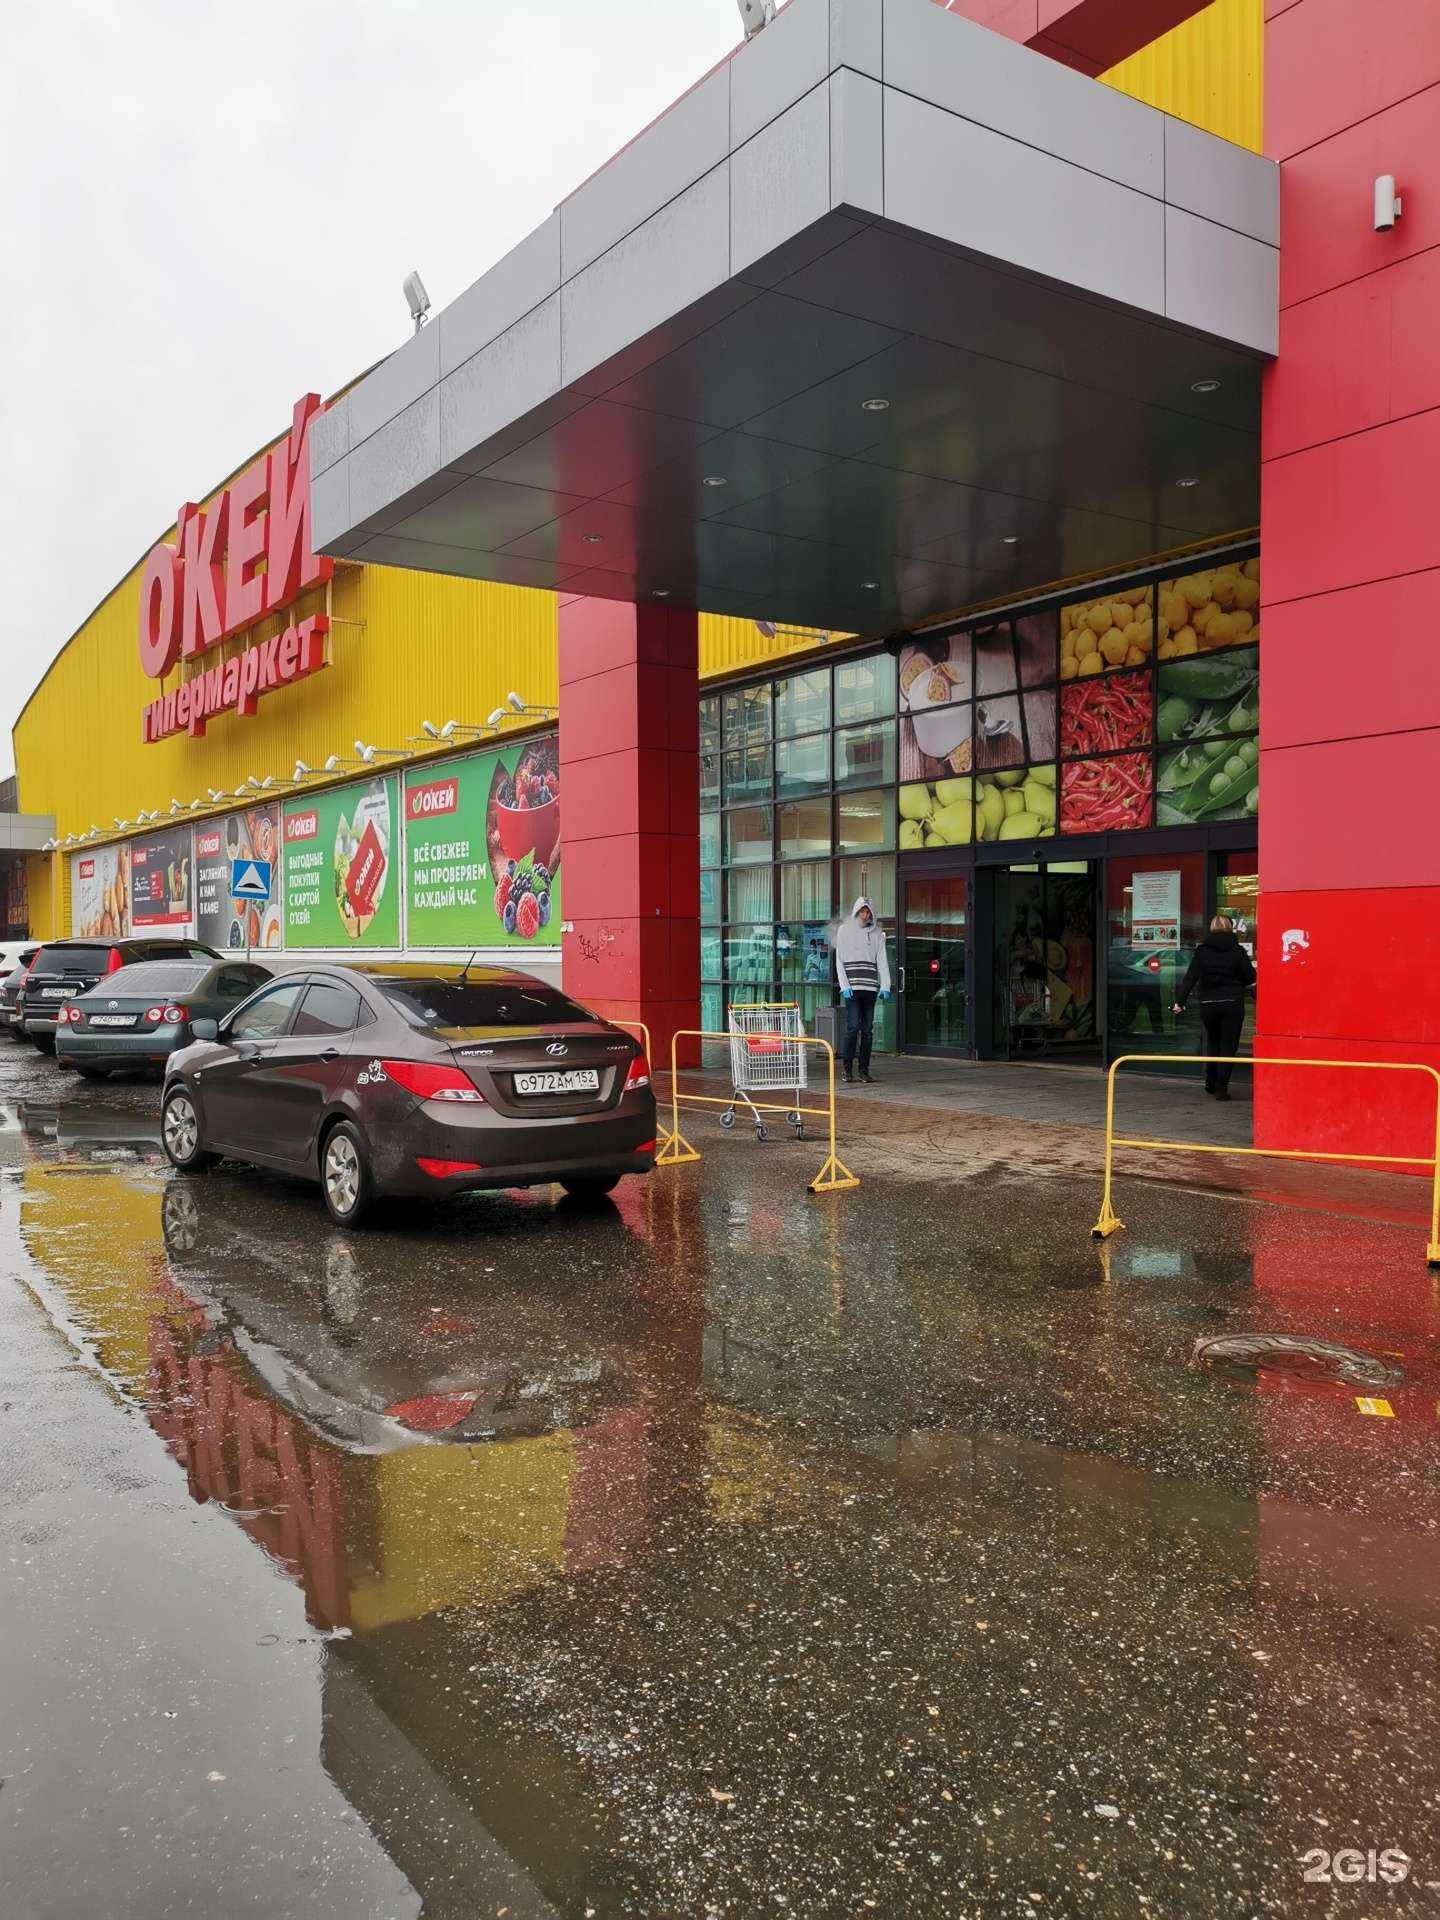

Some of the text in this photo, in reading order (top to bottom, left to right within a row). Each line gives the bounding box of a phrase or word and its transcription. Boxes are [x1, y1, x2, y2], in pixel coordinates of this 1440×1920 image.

[143, 614, 329, 744] гипермаркет
[289, 852, 323, 870] ВЫГОДНЫЕ
[414, 841, 469, 864] ВСЁ СВЕЖЕЕ!
[289, 872, 320, 888] ПОКУПКИ
[414, 863, 487, 886] МЫ ПРОВЕРЯЕМ
[289, 888, 320, 907] С КАРТОЙ
[414, 886, 477, 909] КАЖДЫЙ ЧАС
[575, 1072, 594, 1083] 152
